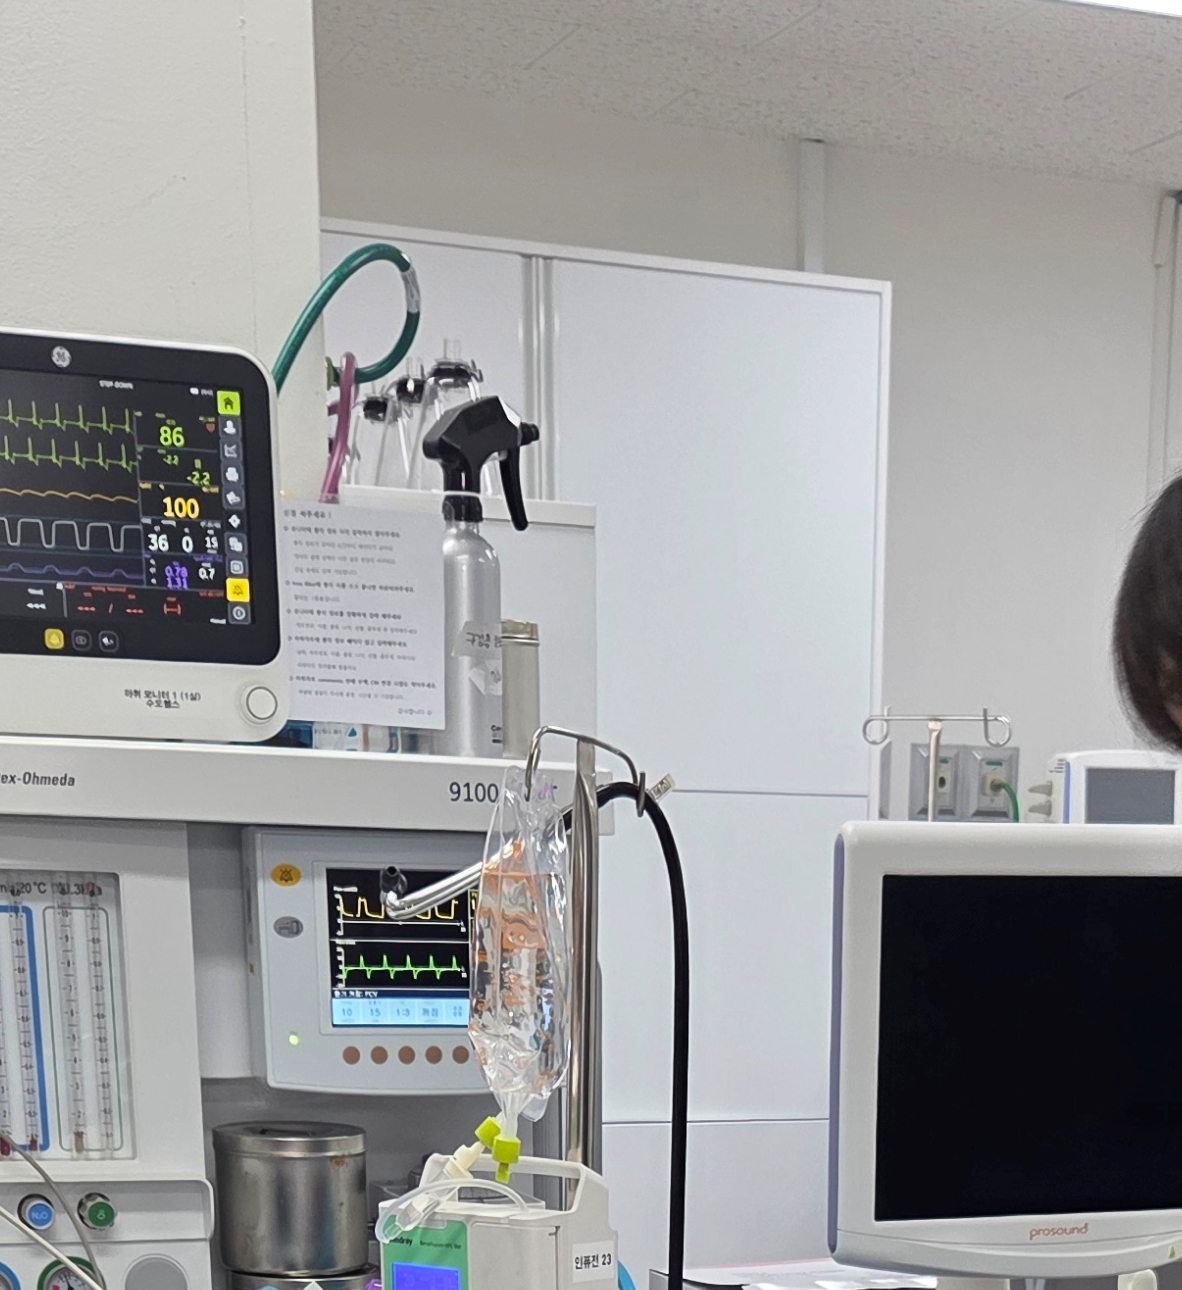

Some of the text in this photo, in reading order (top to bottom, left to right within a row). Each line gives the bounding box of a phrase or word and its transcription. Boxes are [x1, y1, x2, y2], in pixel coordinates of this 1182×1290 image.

[160, 426, 185, 447] 86
[162, 496, 200, 518] 100
[148, 533, 169, 552] 36
[182, 536, 193, 553] 0
[198, 567, 215, 580] 0.7
[144, 690, 170, 701] 모니터
[0, 771, 76, 787] ex-Ohmeda
[449, 781, 500, 803] 9100
[1029, 1222, 1088, 1241] prosound
[574, 1253, 612, 1270] 인퓨전 23
